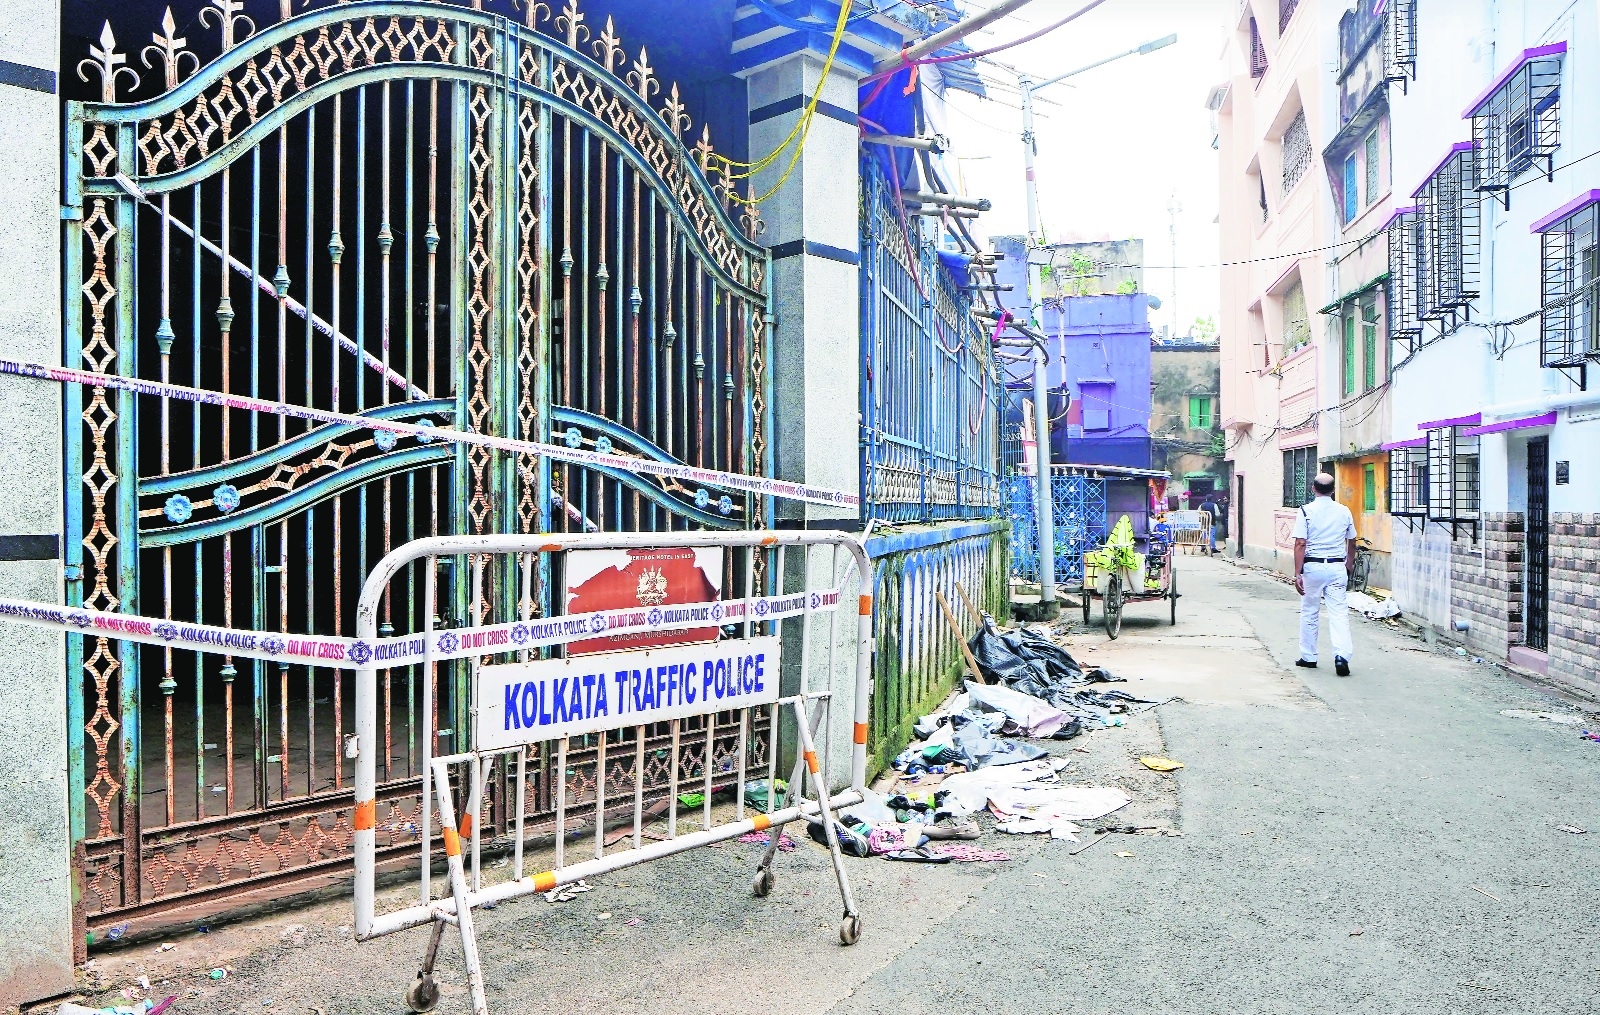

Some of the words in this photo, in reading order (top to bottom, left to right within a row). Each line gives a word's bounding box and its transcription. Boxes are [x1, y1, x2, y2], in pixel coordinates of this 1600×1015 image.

[770, 599, 792, 614] KOLKATA
[822, 594, 829, 606] DO
[829, 593, 839, 605] NOT
[608, 614, 616, 629] DO
[617, 613, 628, 628] NOT
[628, 612, 646, 627] CROSS
[663, 609, 690, 624] KOLKATA
[690, 607, 710, 621] POLICE
[93, 616, 108, 629] DO
[107, 618, 125, 632] NOT
[124, 620, 153, 636] CROSS
[530, 622, 563, 640] KOLKATA
[564, 619, 588, 636] POLICE
[180, 627, 224, 646] KOLKATA
[224, 632, 257, 650] POLICE
[461, 633, 472, 650] DO
[472, 631, 487, 648] NOT
[487, 629, 509, 646] CROSS
[287, 639, 299, 655] DO
[300, 641, 318, 657] NOT
[317, 643, 345, 660] CROSS
[374, 641, 408, 661] KOLKATA
[504, 672, 609, 731] KOLKATA
[615, 662, 697, 715] TRAFFIC
[702, 653, 765, 702] POLICE
